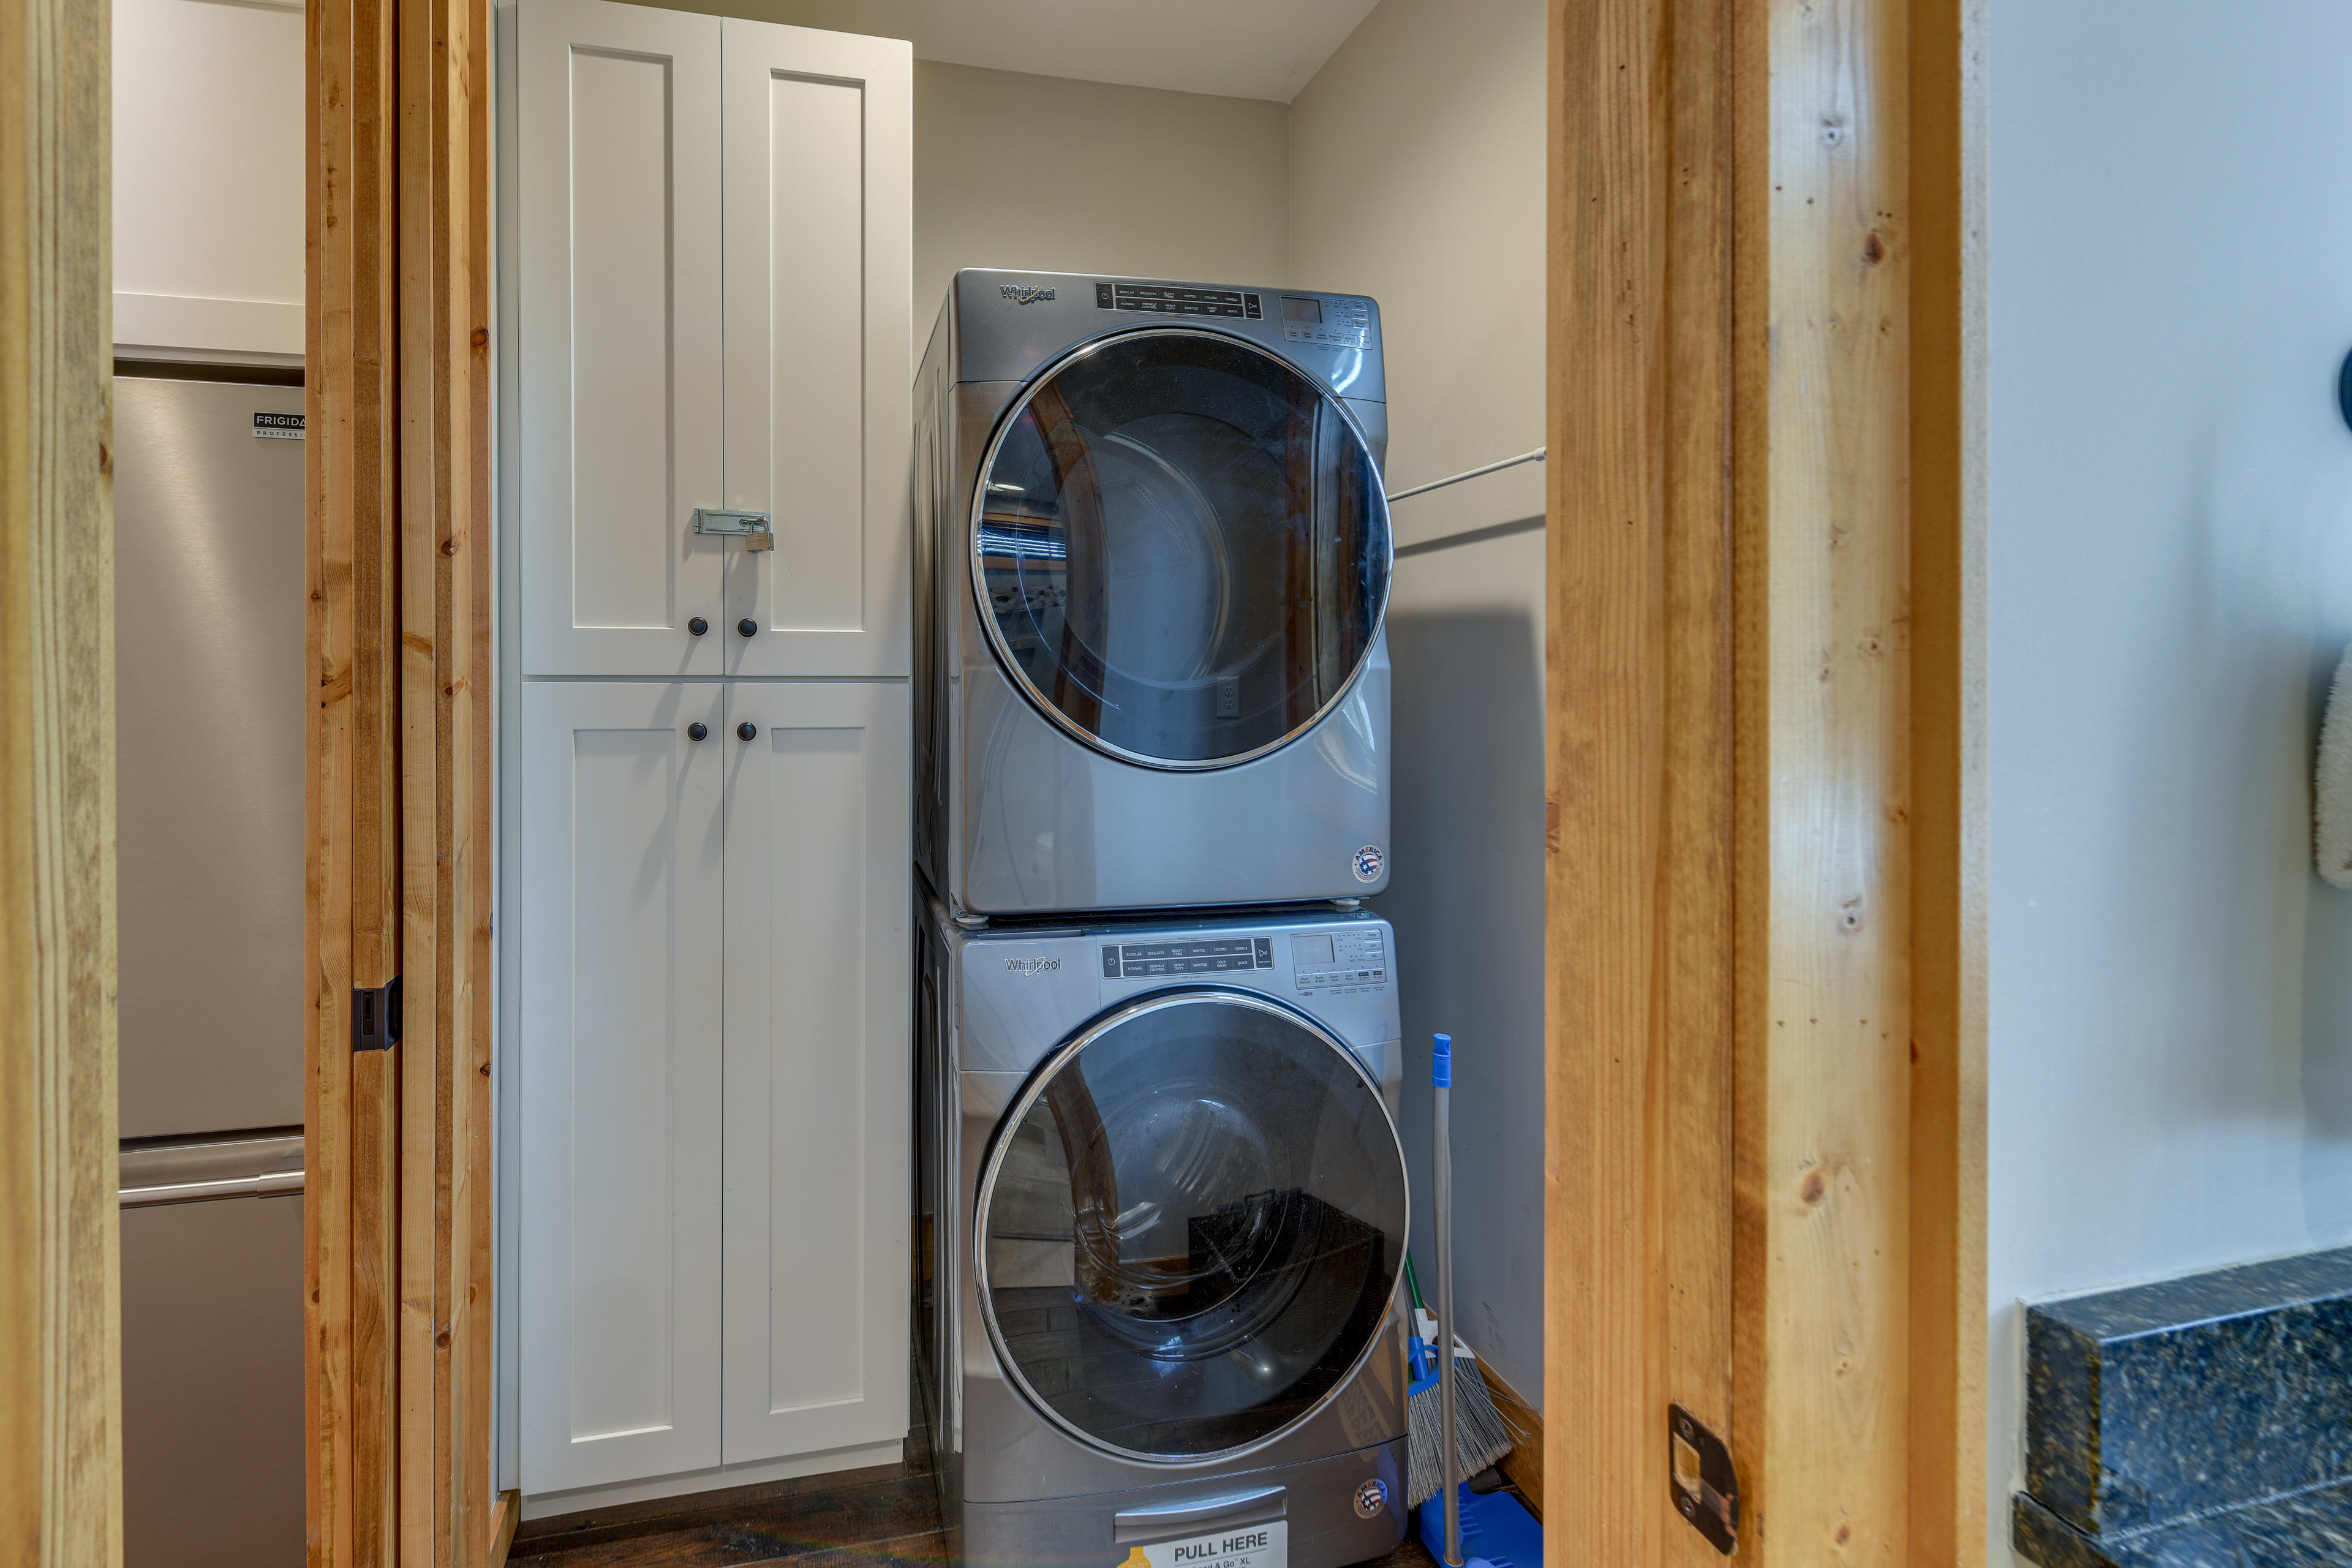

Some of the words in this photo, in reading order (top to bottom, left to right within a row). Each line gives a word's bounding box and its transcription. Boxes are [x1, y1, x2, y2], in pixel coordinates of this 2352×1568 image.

[1000, 285, 1056, 303] Whirlpool
[1355, 846, 1382, 861] AMERICA
[1005, 957, 1061, 974] Whirlpool
[1357, 1481, 1385, 1498] AMERICA
[1175, 1542, 1217, 1561] PULL
[1223, 1532, 1268, 1553] HERE
[1240, 1556, 1251, 1566] XL
